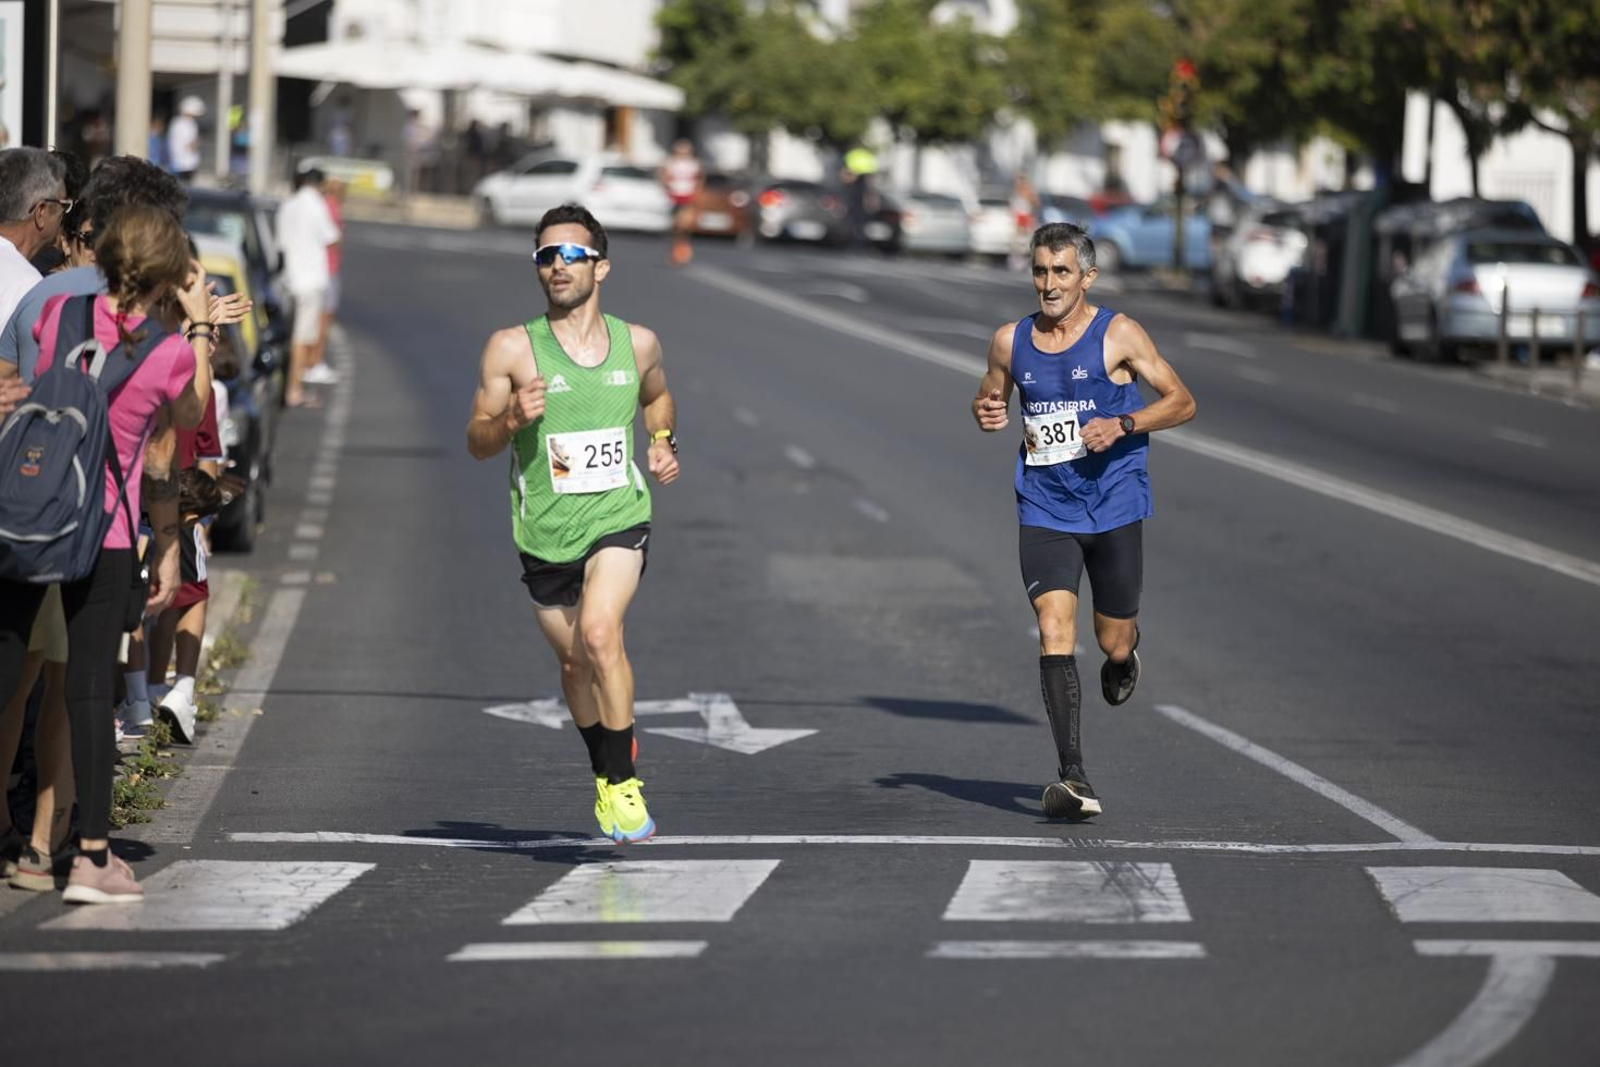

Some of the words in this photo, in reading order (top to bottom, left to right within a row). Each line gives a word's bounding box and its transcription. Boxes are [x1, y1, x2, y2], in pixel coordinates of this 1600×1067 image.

[1027, 399, 1096, 413] ROTASIERRA
[1040, 420, 1075, 445] 387
[584, 440, 623, 468] 255
